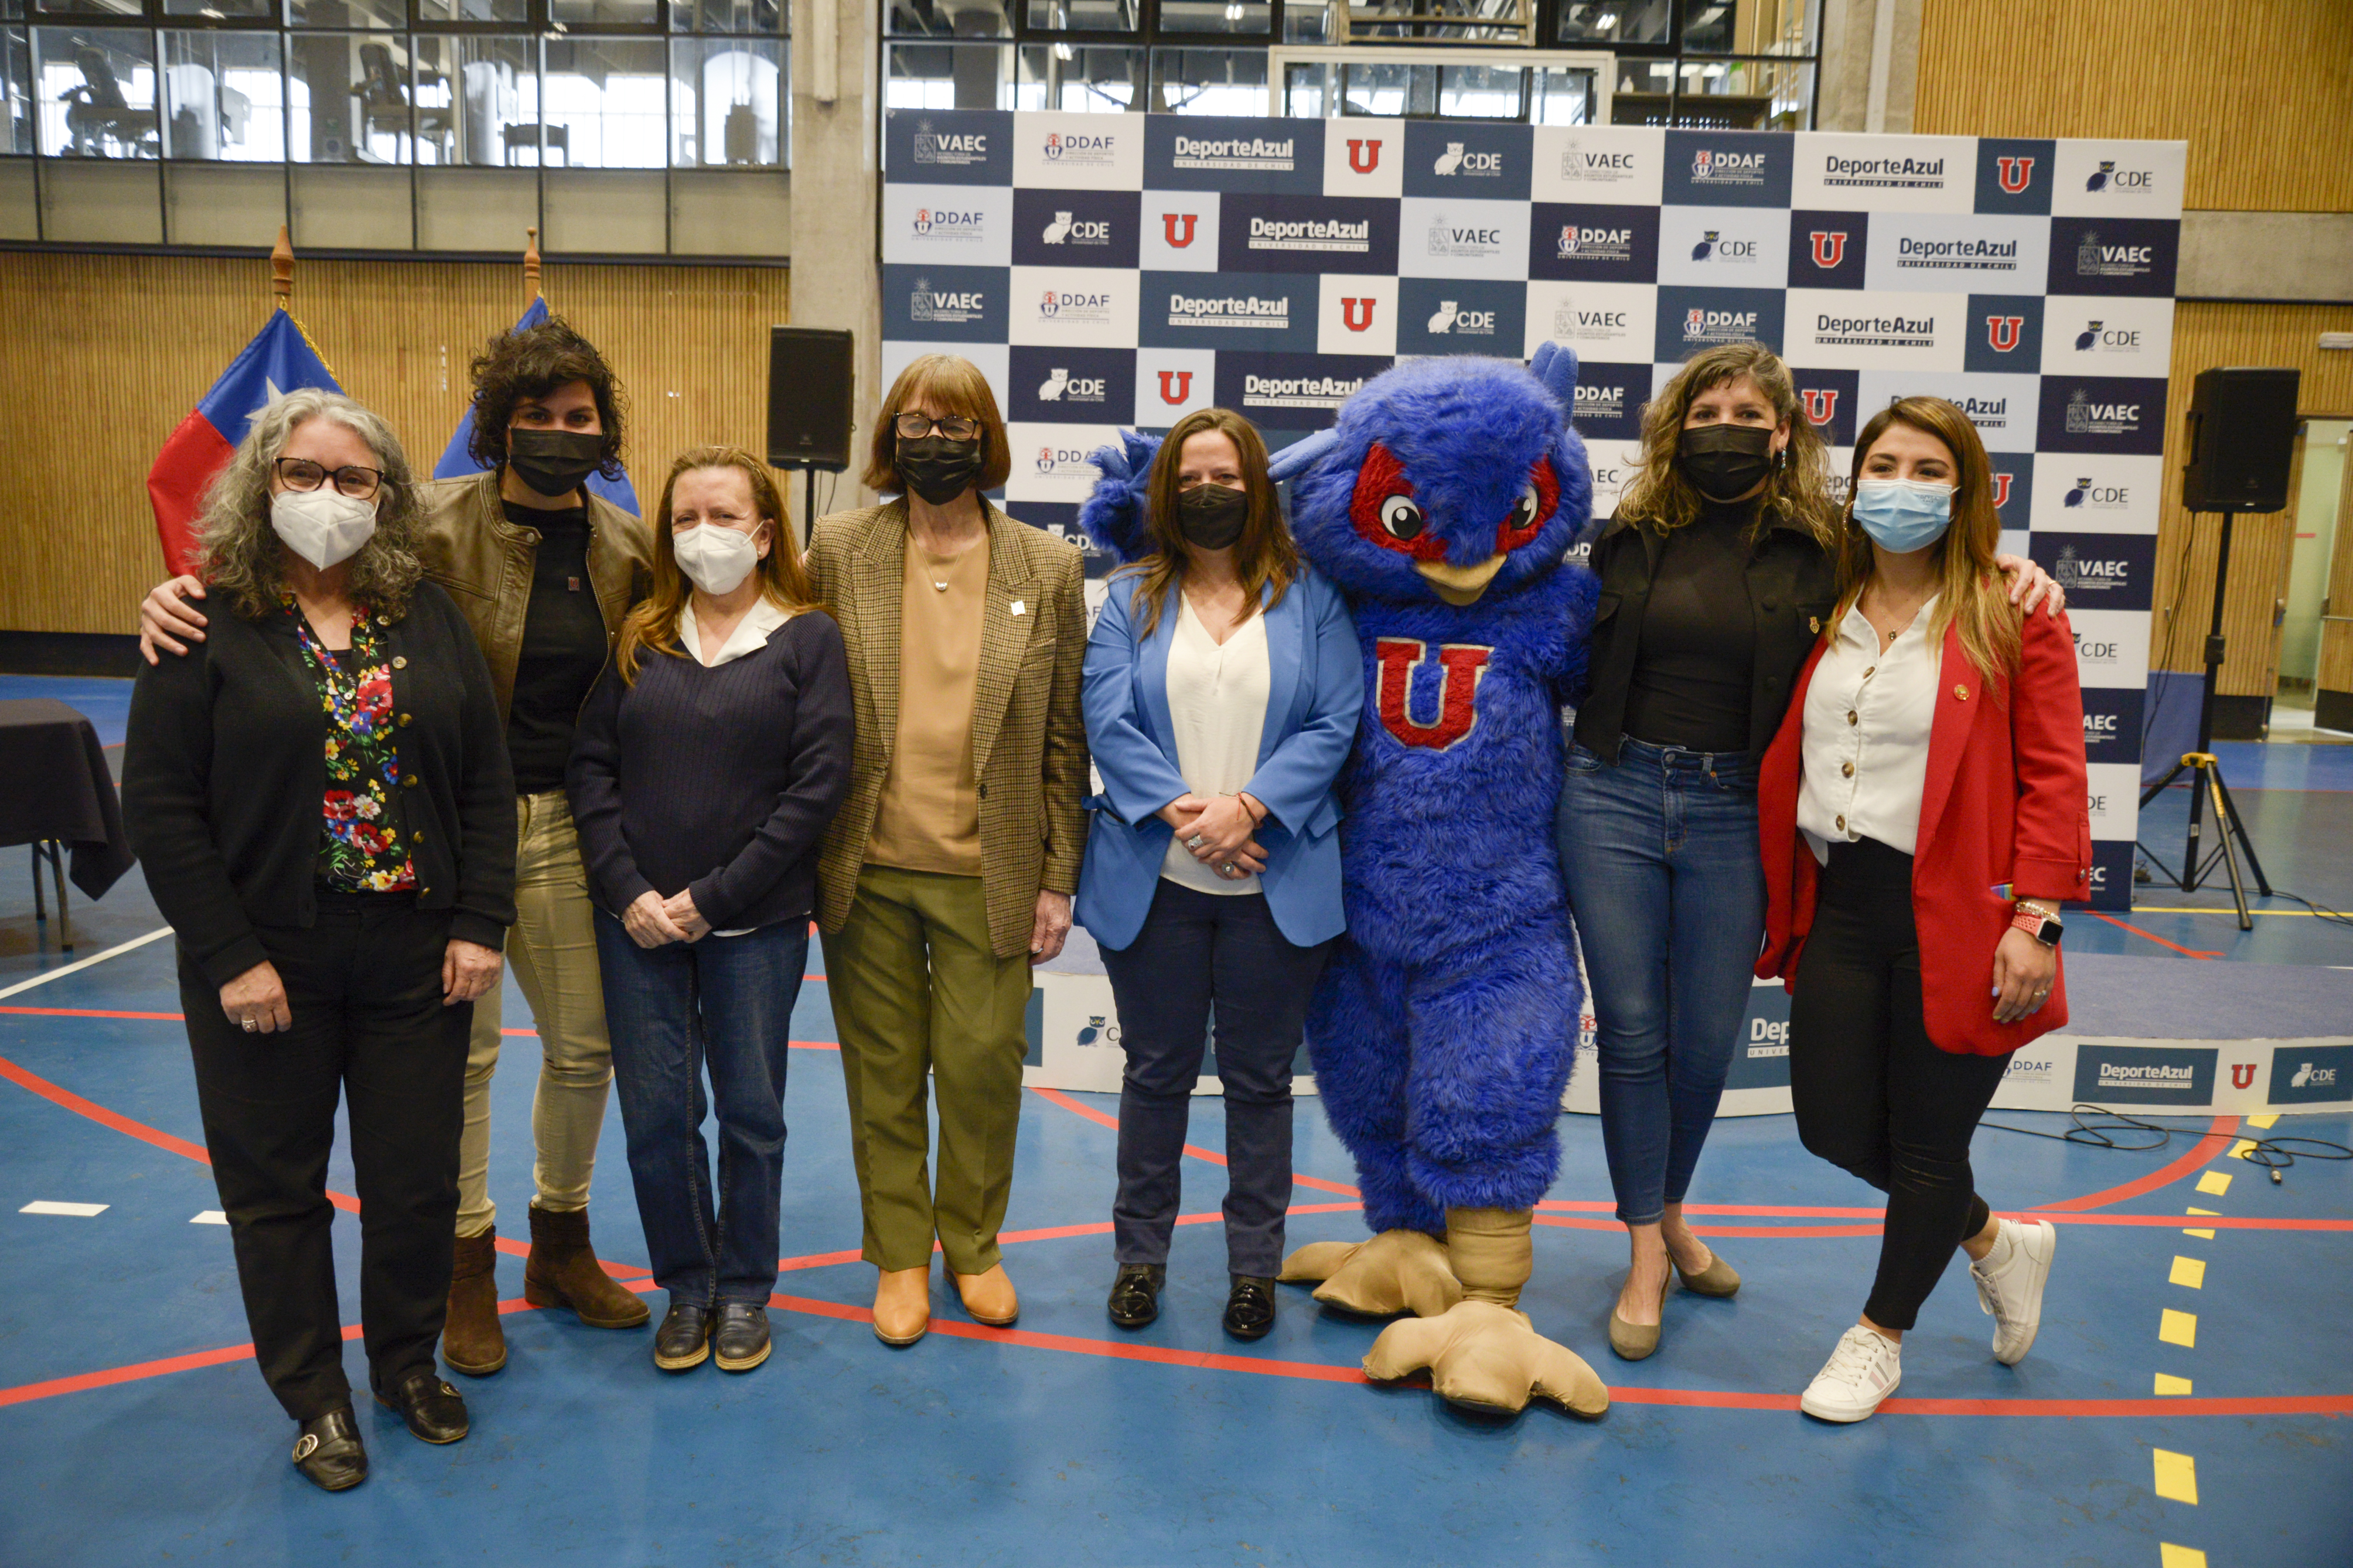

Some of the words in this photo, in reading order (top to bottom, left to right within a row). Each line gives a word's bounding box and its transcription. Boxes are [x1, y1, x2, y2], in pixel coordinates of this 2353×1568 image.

[937, 135, 986, 152] VAEC
[1066, 136, 1114, 149] DDAF
[1347, 139, 1382, 173] U
[1463, 153, 1501, 170] CDE
[1585, 153, 1634, 168] VAEC
[1716, 153, 1765, 168] DDAF
[1997, 157, 2034, 193] U
[2115, 172, 2152, 187] CDE
[935, 211, 983, 225] DDAF
[1071, 222, 1109, 238] CDE
[1163, 214, 1198, 248] U
[1452, 229, 1500, 244] VAEC
[1581, 229, 1631, 244] DDAF
[1720, 241, 1756, 257] CDE
[1810, 232, 1846, 268] U
[2102, 247, 2151, 263] VAEC
[934, 293, 983, 309] VAEC
[1062, 294, 1110, 307] DDAF
[1341, 298, 1376, 332] U
[1457, 312, 1495, 328] CDE
[1578, 312, 1626, 327] VAEC
[1707, 312, 1757, 326] DDAF
[1987, 316, 2023, 352] U
[2103, 331, 2140, 346] CDE
[1067, 379, 1105, 395] CDE
[1158, 371, 1193, 405] U
[1574, 386, 1624, 401] DDAF
[1802, 390, 1837, 425] U
[2090, 405, 2139, 421] VAEC
[2092, 487, 2129, 503] CDE
[2079, 561, 2127, 577] VAEC
[2081, 643, 2117, 657] CDE
[1376, 637, 1495, 753] U
[2083, 715, 2117, 730] AEC
[2088, 796, 2106, 810] DE
[2014, 1061, 2052, 1071] DDAF
[2232, 1064, 2257, 1089] U
[2311, 1070, 2336, 1081] CDE
